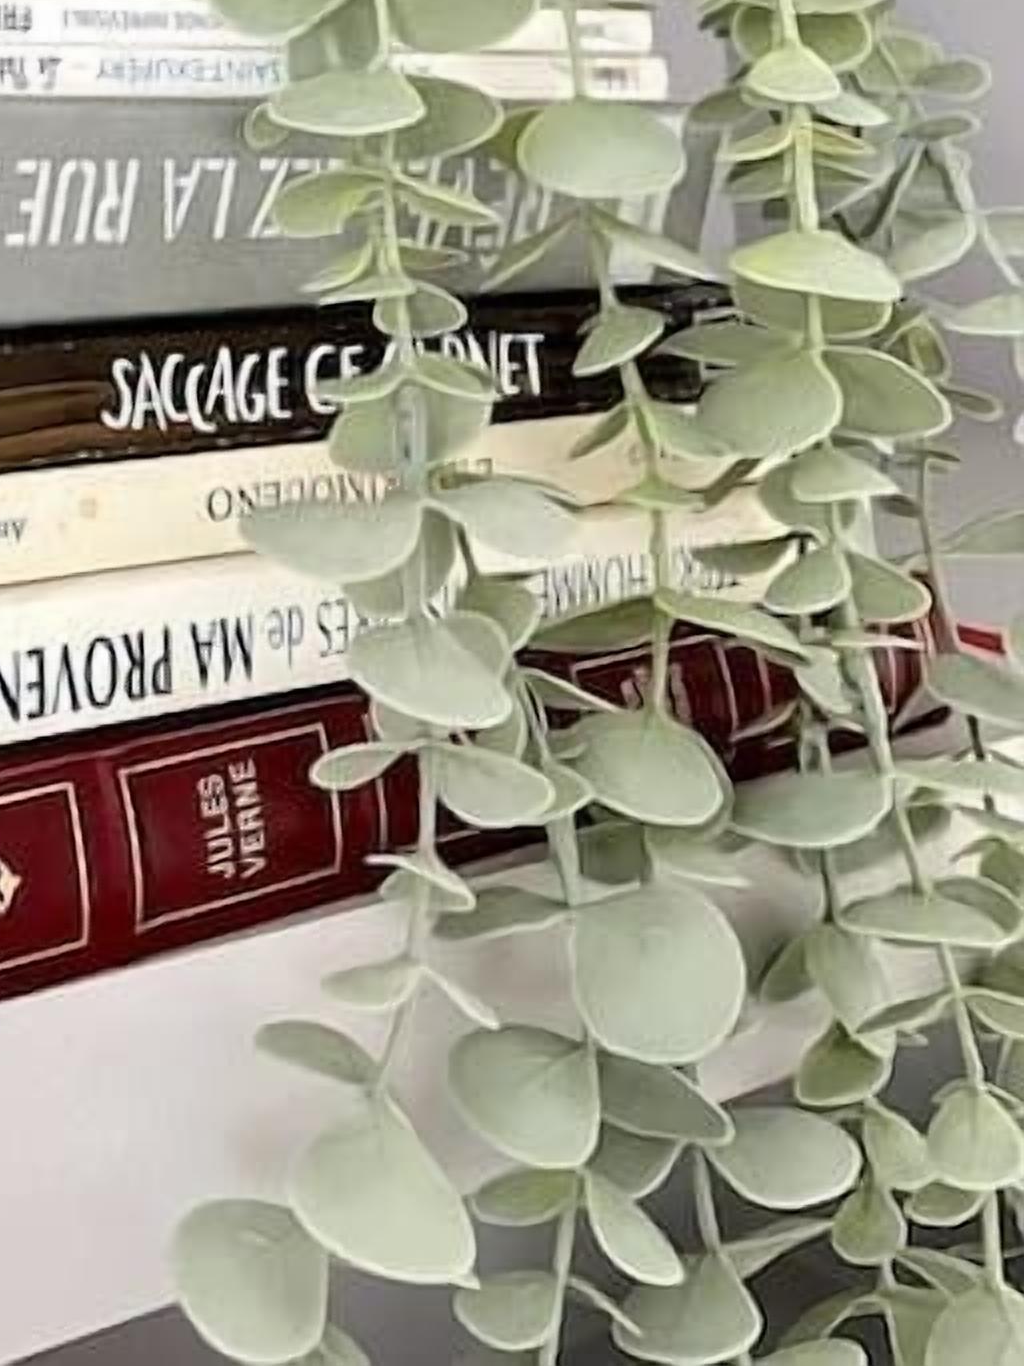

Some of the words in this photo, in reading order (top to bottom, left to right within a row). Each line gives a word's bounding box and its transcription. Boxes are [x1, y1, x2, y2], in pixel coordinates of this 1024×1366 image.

[164, 156, 236, 243] LA
[102, 345, 291, 433] SACCAGE
[190, 609, 255, 689] MA
[266, 604, 304, 669] de
[196, 773, 236, 878] JULES
[227, 757, 266, 878] VERNE
